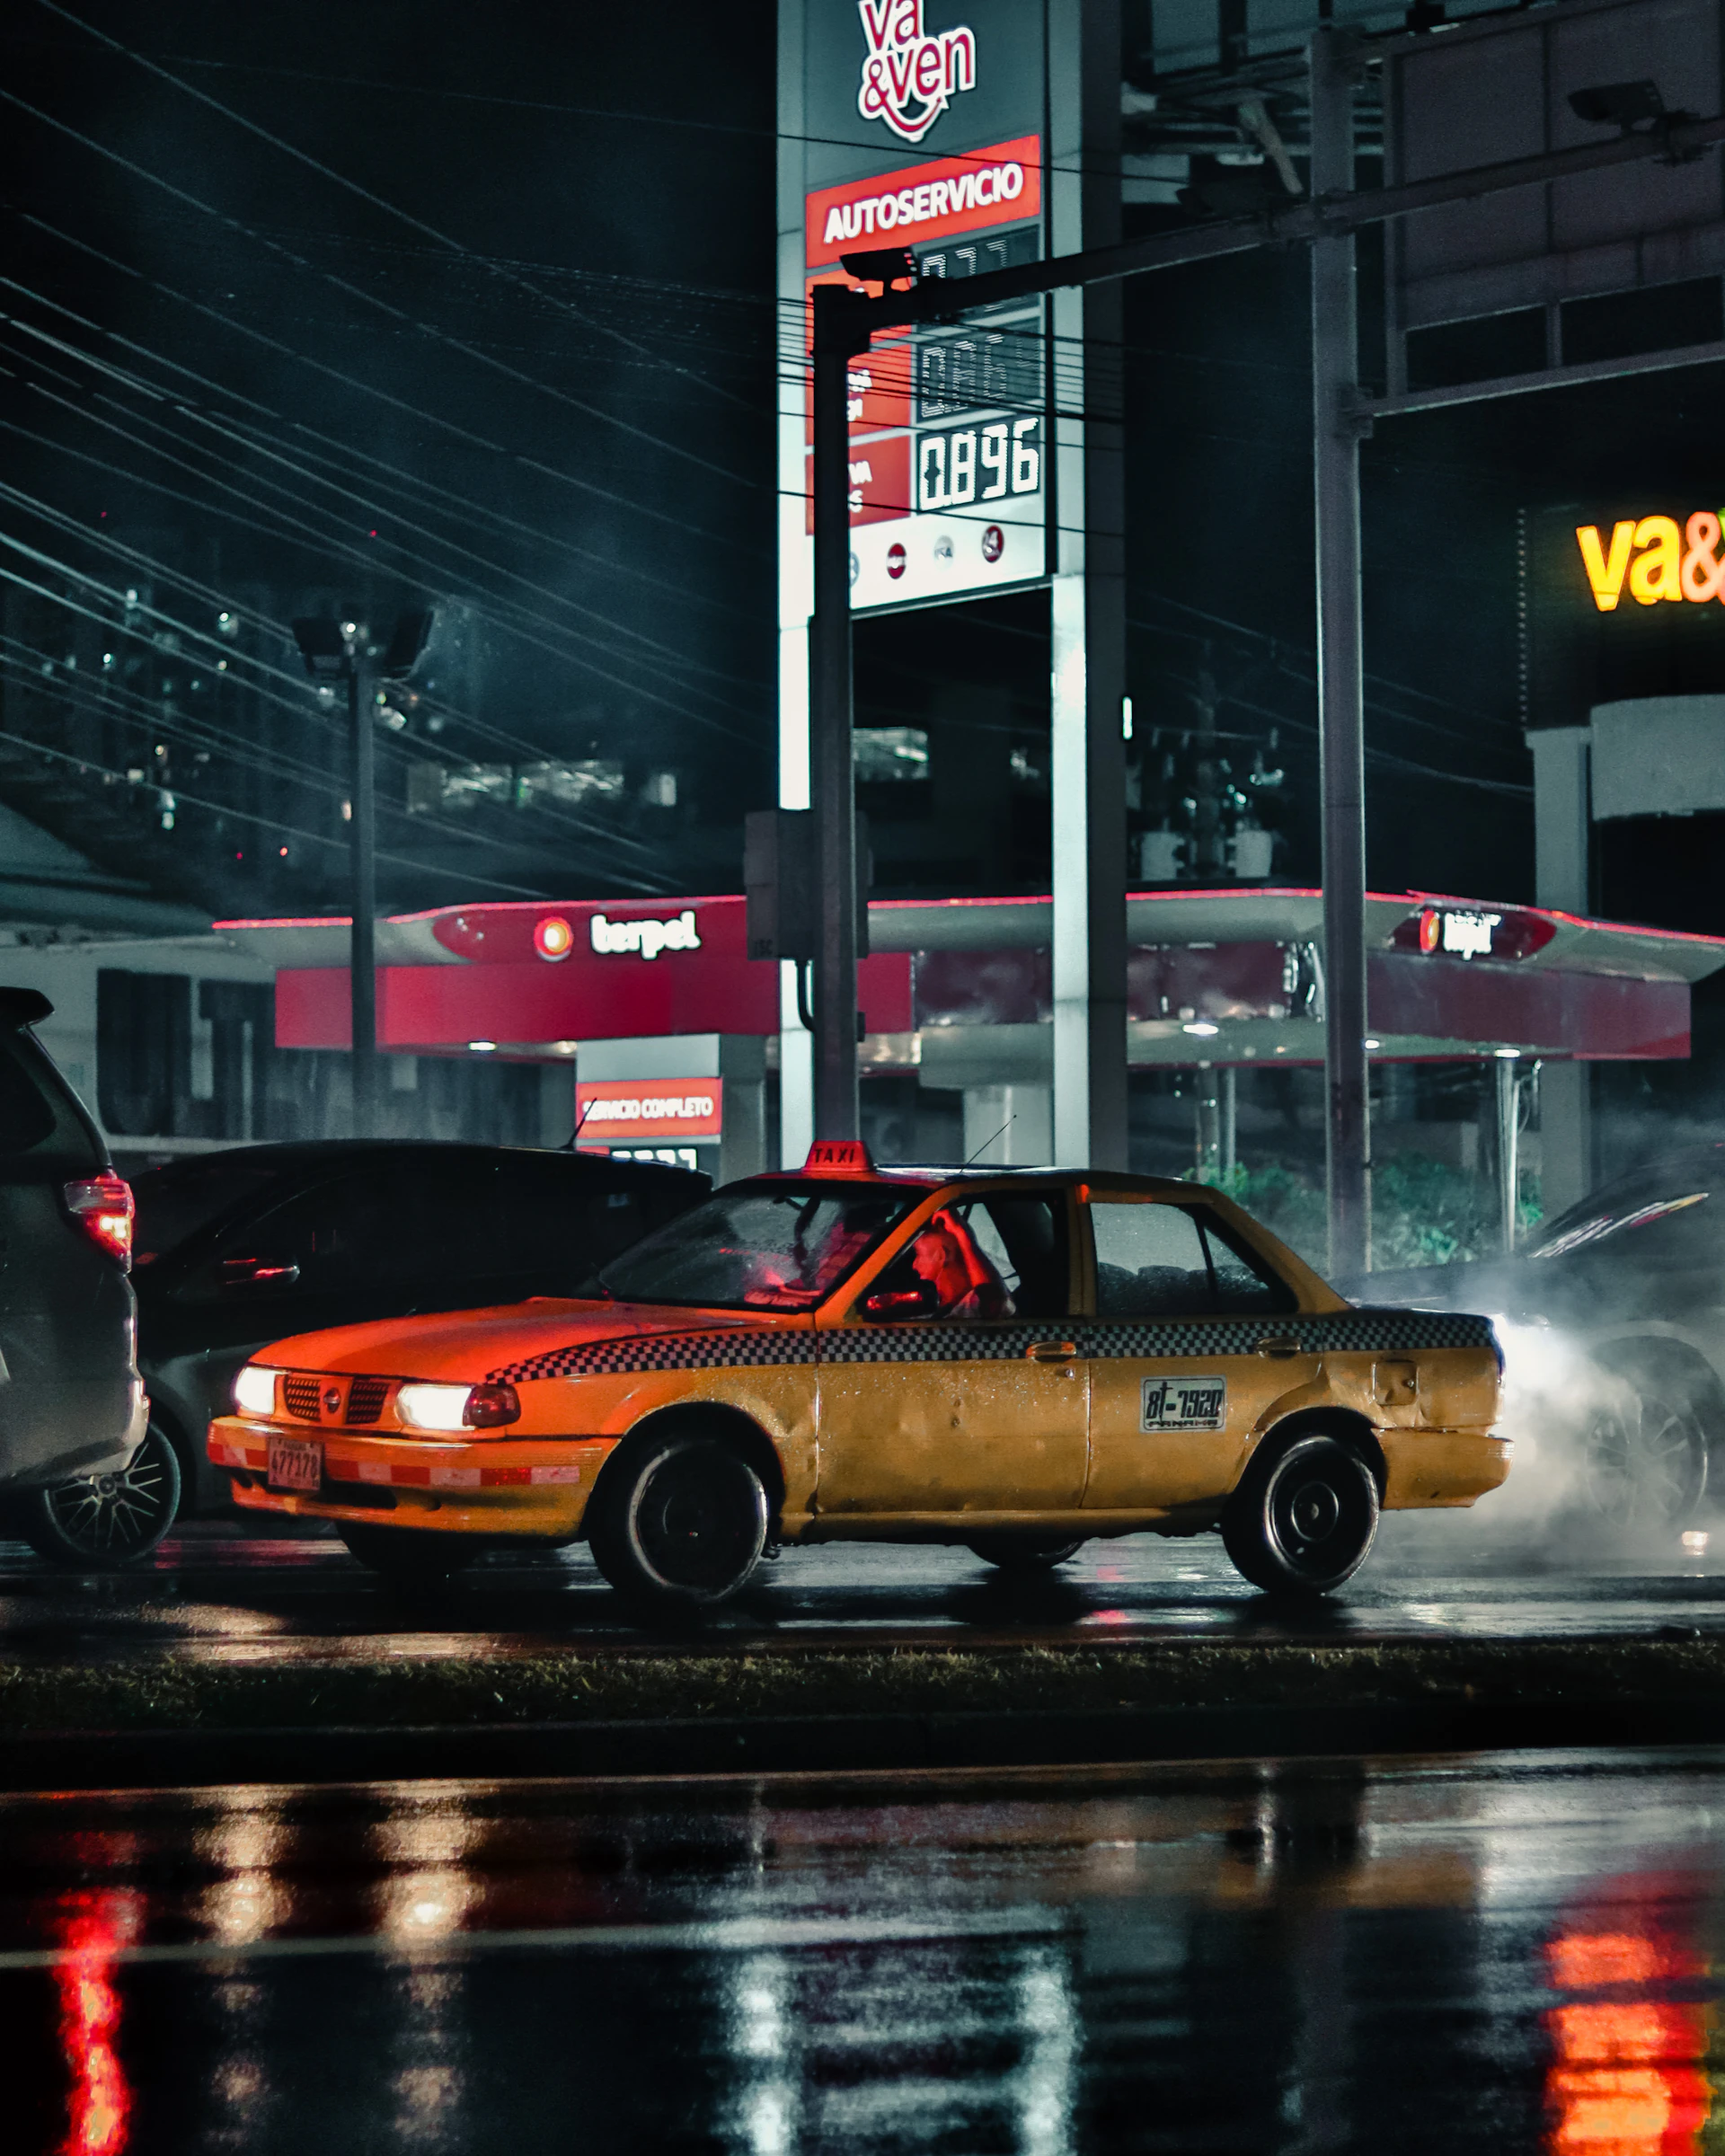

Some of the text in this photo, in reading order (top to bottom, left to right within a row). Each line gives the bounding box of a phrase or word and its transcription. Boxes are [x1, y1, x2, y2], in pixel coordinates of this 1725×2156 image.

[859, 0, 924, 52] va
[823, 163, 1023, 244] AUTOSERVICIO
[1576, 508, 1725, 612] va&
[641, 1096, 713, 1118] COMPLETO
[812, 1148, 854, 1163] TAXI
